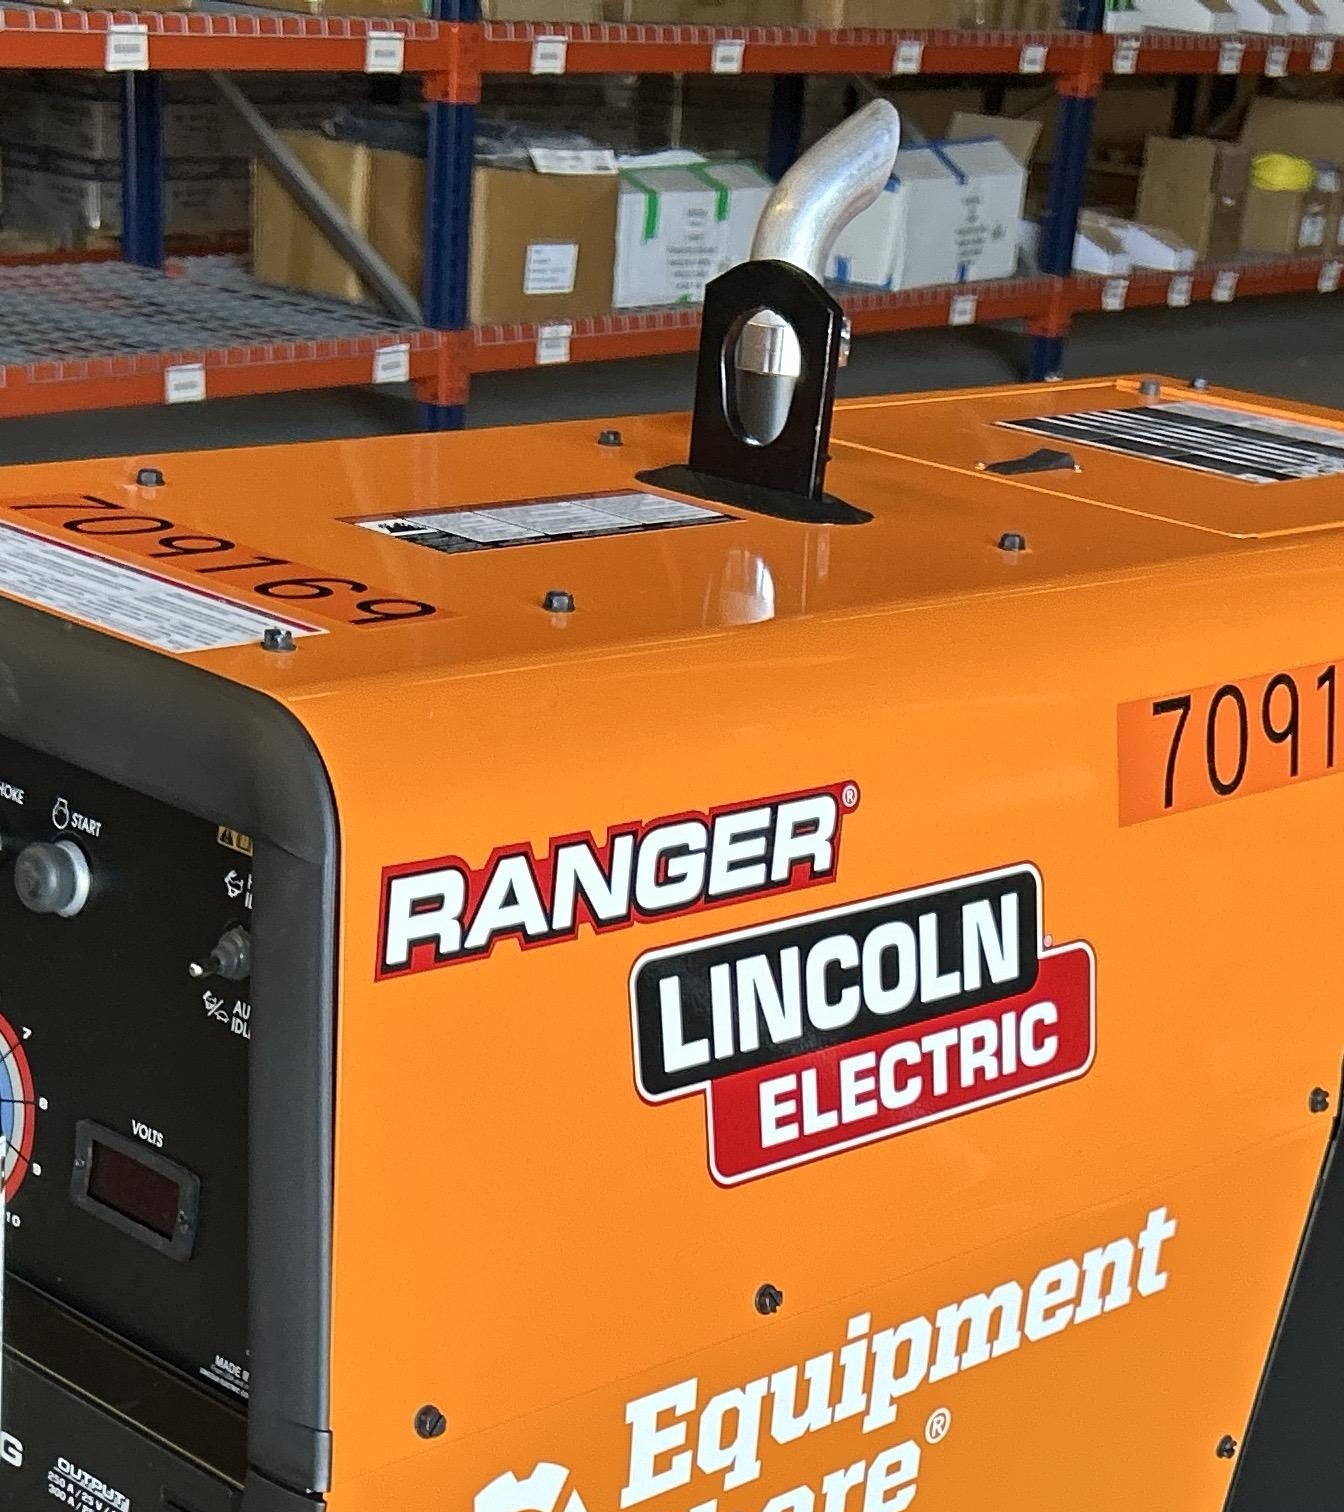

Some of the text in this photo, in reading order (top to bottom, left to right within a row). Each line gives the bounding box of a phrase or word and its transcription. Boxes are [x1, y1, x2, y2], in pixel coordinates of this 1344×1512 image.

[8, 494, 437, 626] 709169
[71, 812, 102, 837] START
[658, 891, 1022, 1076] LINCOLN
[131, 1119, 165, 1149] VOLTS
[757, 1001, 1062, 1151] ELECTRIC
[620, 1205, 1178, 1511] Equipment
